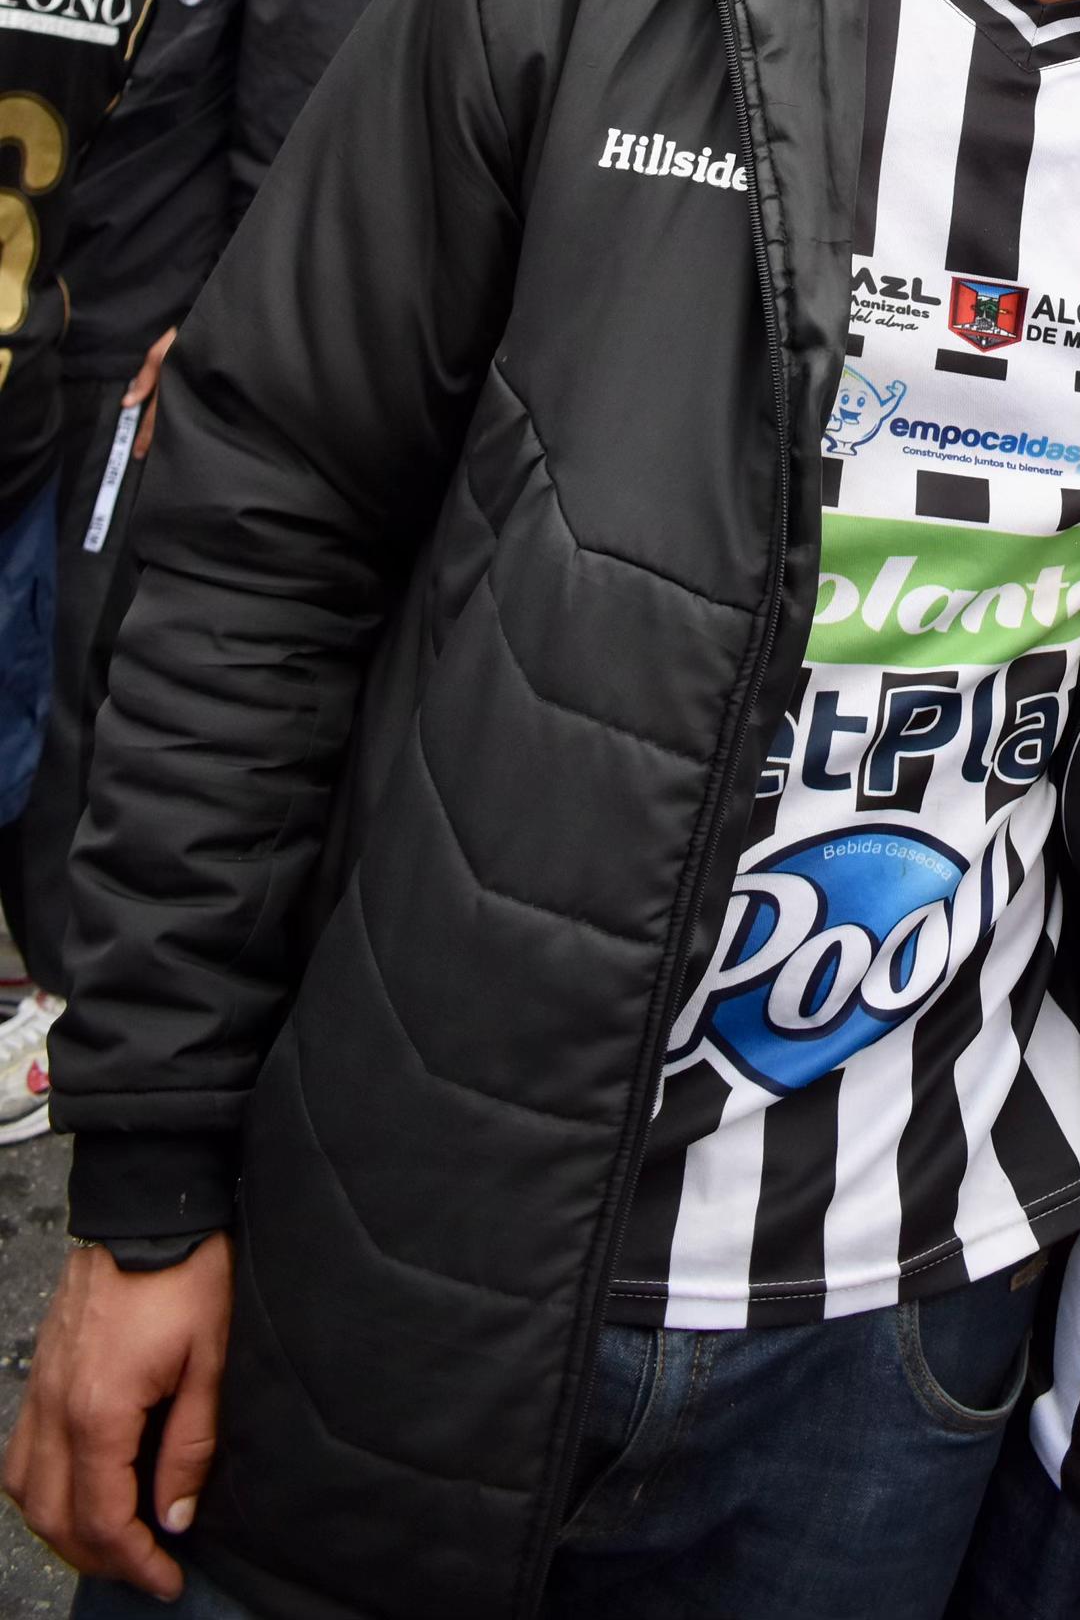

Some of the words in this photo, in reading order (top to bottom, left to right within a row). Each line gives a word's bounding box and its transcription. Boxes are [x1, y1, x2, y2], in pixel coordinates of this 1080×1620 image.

[598, 128, 749, 191] Hillside
[875, 314, 919, 332] alma
[1026, 324, 1058, 345] DE
[902, 445, 973, 464] Construyendo
[973, 455, 1005, 469] juntos
[1006, 460, 1017, 471] tu
[1018, 462, 1064, 477] bienestar
[823, 839, 882, 861] Bebida
[885, 841, 954, 883] Gaseosa
